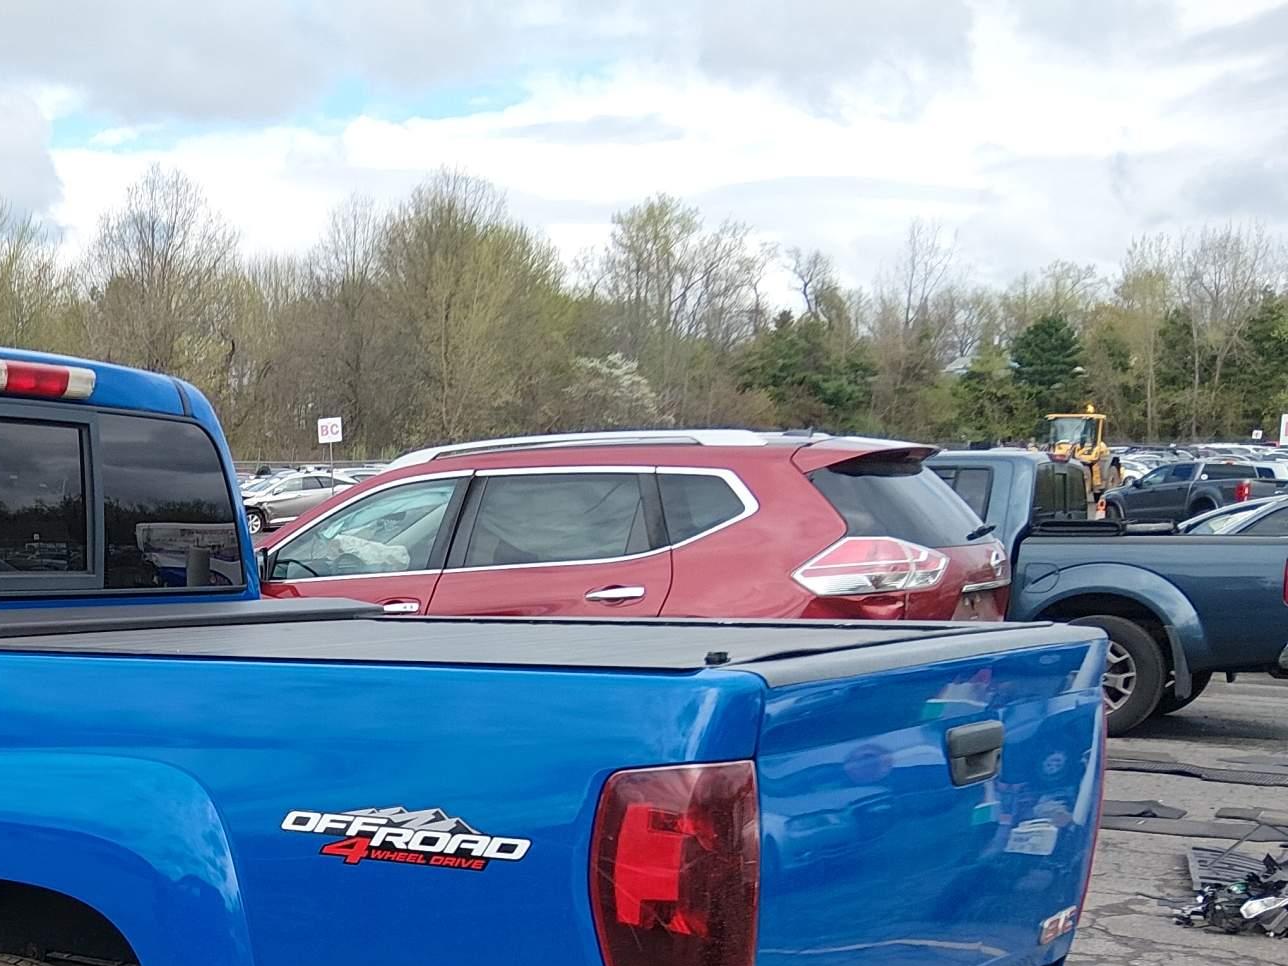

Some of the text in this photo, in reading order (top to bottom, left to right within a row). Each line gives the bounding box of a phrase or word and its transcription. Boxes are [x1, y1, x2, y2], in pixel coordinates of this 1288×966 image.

[320, 423, 340, 437] BC
[322, 836, 485, 870] 4 WHEEL DRIVE
